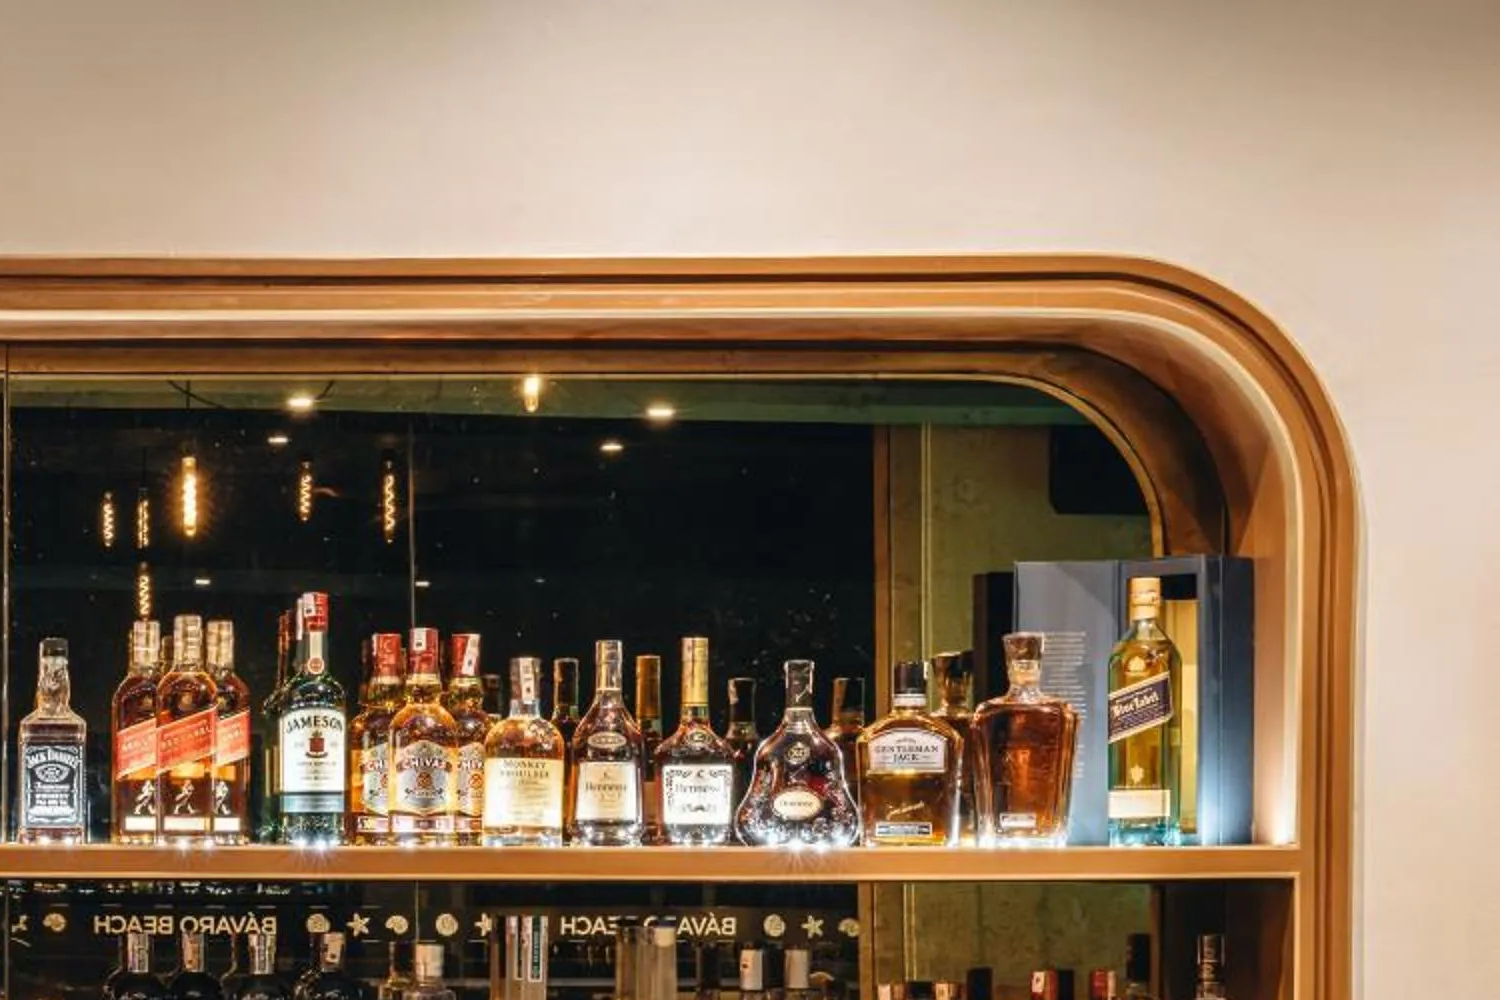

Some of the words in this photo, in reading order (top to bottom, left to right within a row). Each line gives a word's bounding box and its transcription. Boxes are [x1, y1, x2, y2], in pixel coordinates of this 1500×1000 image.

[286, 714, 344, 735] JAMESON
[875, 745, 939, 754] GENTLEMAN
[893, 753, 919, 763] JACK
